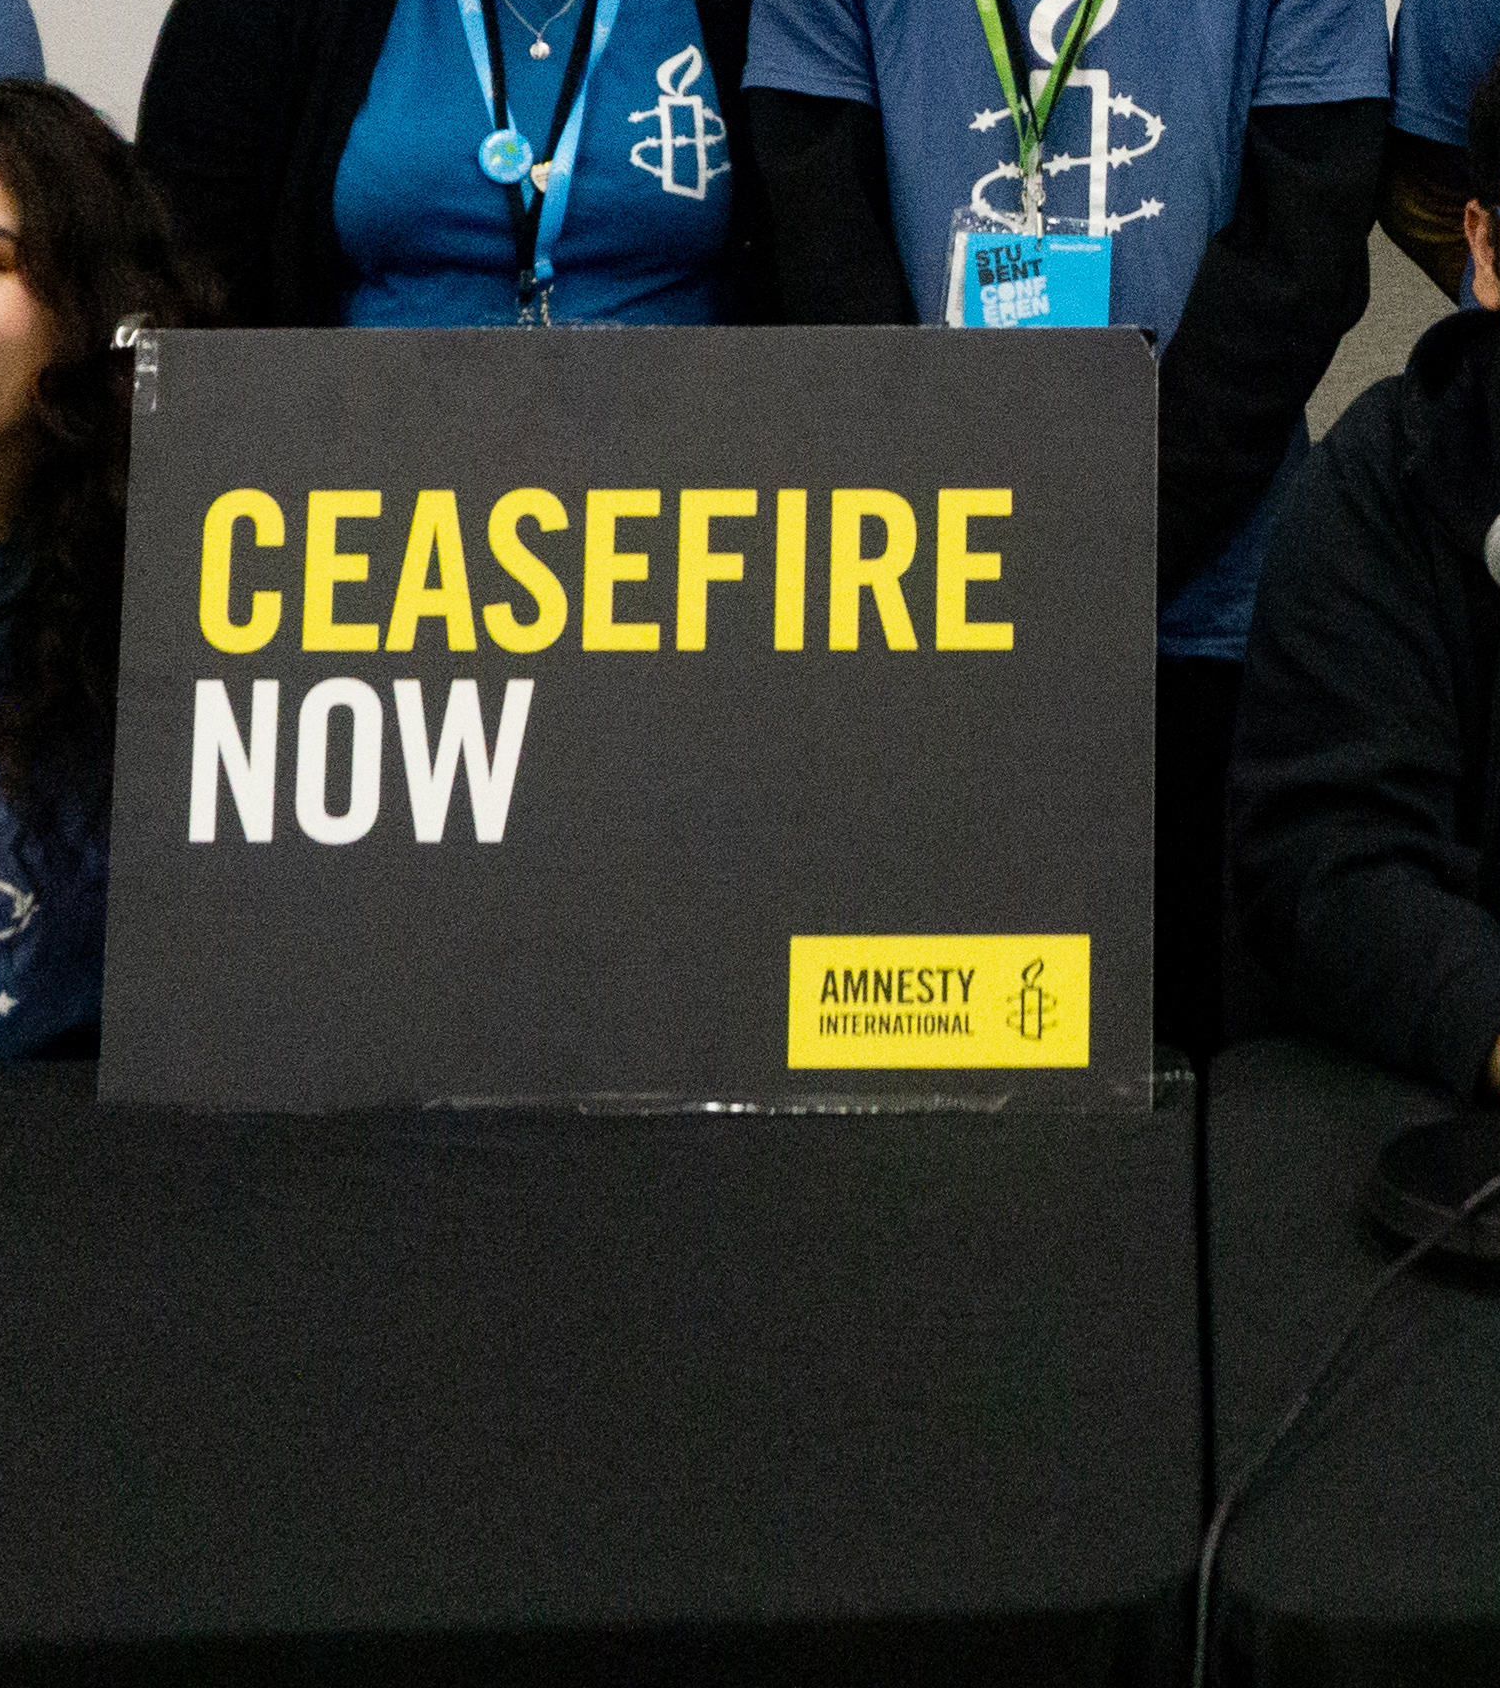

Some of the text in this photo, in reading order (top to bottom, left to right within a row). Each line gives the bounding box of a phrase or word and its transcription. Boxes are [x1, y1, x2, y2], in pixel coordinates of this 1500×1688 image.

[975, 244, 1022, 268] STU
[198, 487, 1015, 655] CEASEFIRE
[188, 676, 536, 846] NOW
[820, 967, 976, 1004] AMNESTY
[818, 1012, 974, 1037] INTERNATIONAL
